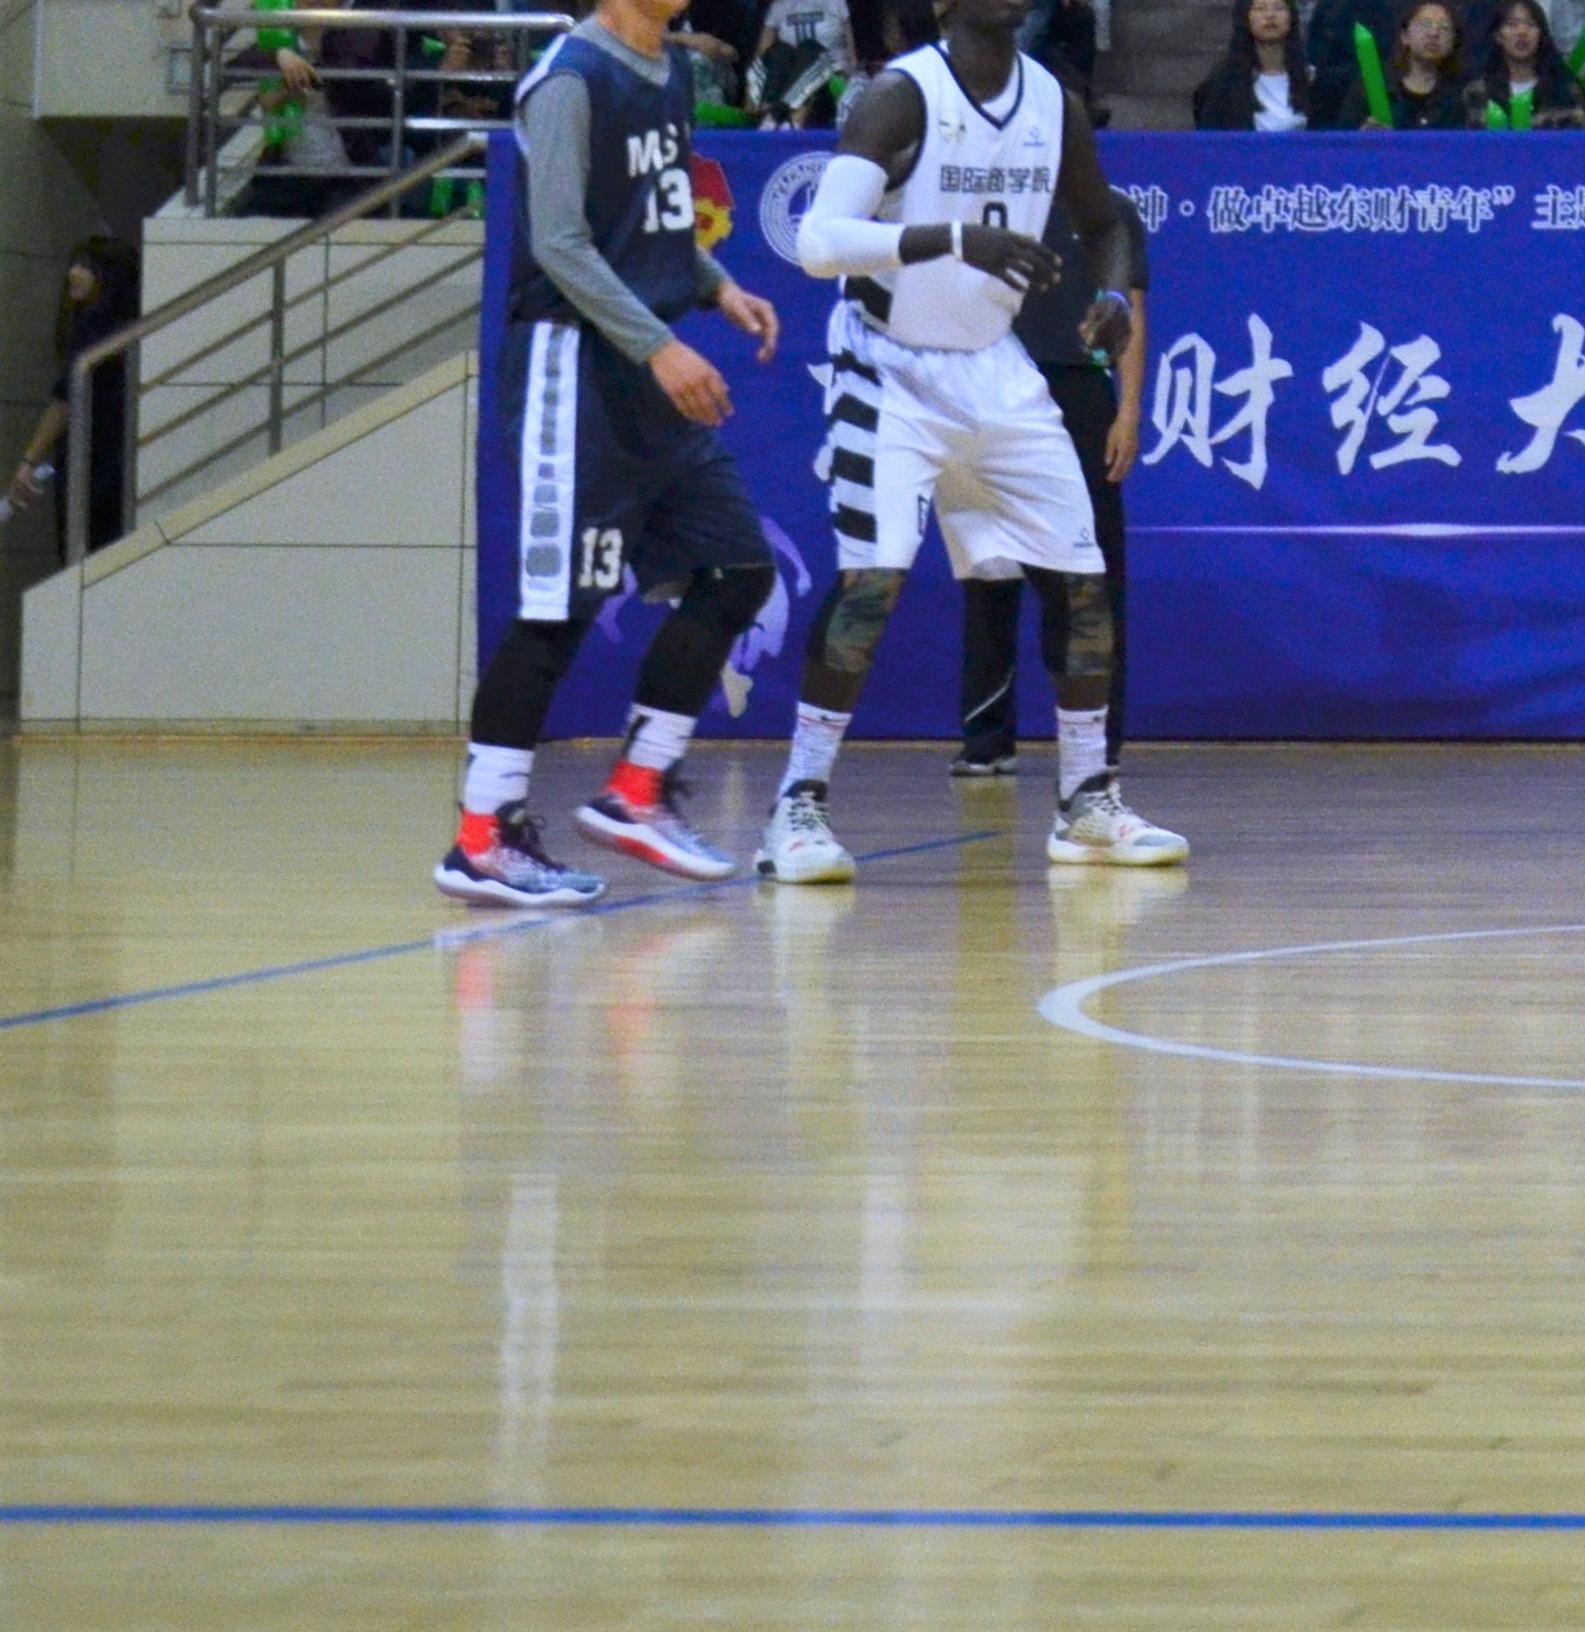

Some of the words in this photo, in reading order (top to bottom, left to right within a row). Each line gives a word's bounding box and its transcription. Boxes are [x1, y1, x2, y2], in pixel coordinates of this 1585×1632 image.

[627, 122, 690, 177] MS
[644, 167, 695, 233] 13
[940, 165, 1053, 194] 国际商学院
[579, 527, 624, 588] 13
